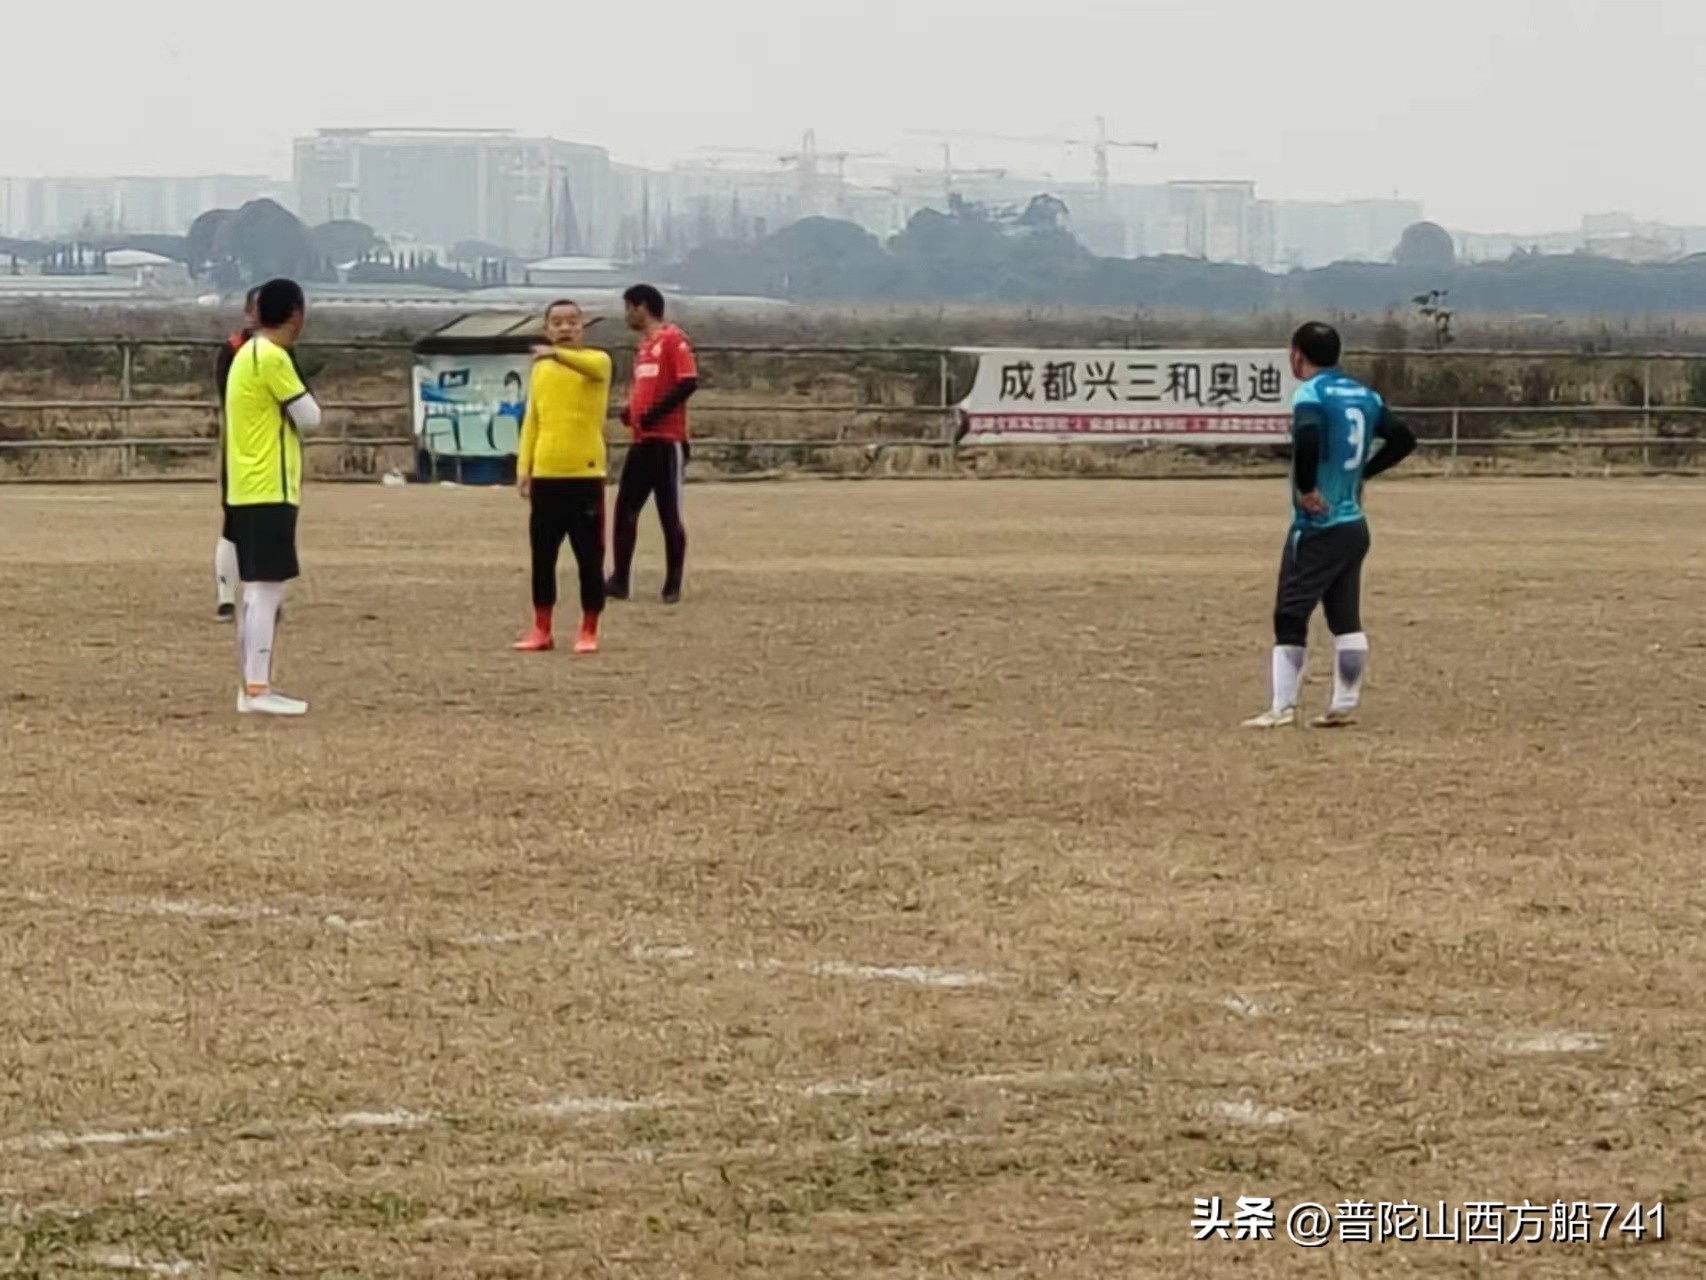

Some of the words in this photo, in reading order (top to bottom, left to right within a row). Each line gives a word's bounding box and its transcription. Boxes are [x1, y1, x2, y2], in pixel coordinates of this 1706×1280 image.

[999, 360, 1281, 404] 成都兴三和奥迪
[1344, 408, 1366, 469] 3
